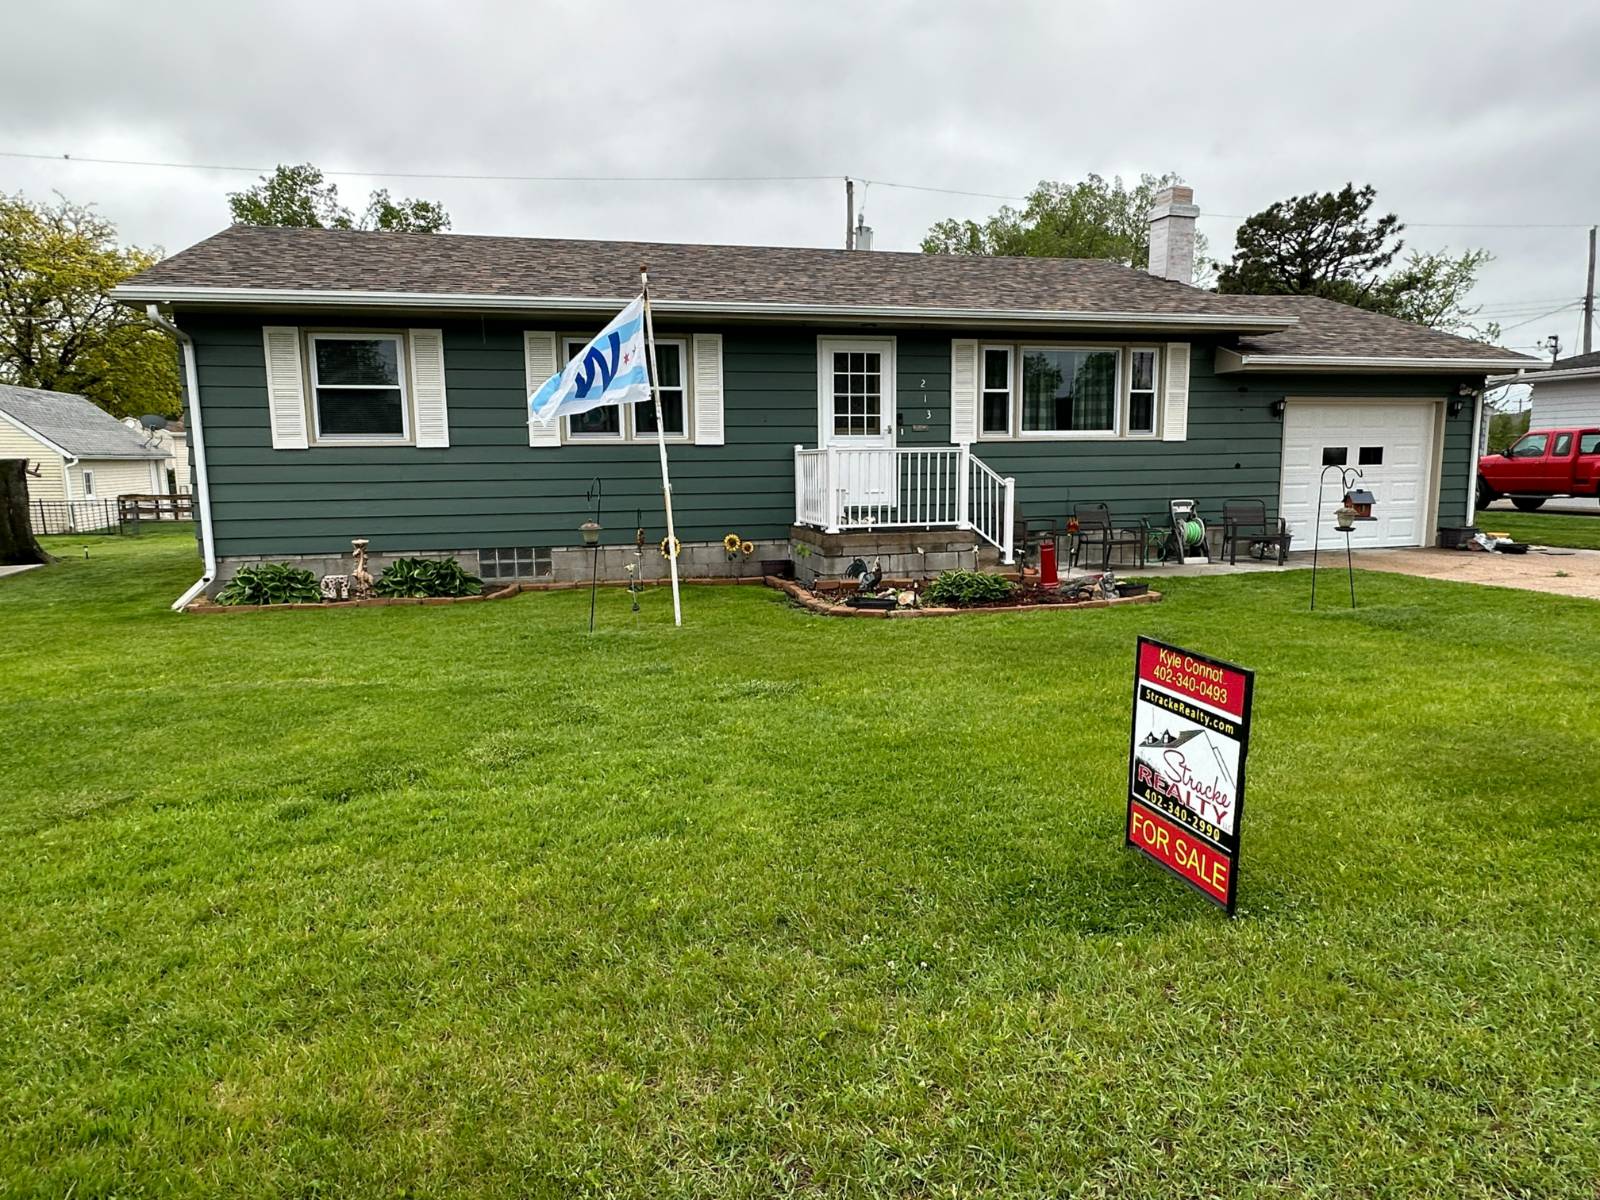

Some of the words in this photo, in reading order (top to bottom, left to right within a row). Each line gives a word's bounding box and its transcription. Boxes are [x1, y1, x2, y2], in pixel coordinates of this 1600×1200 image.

[1153, 665, 1228, 704] 402-340-0493
[1159, 648, 1181, 669] Kyle
[1184, 656, 1223, 684] Connot
[1145, 689, 1235, 735] StrackeRealty.com
[1137, 763, 1228, 825] REALTY
[1163, 749, 1231, 808] Stracke
[1144, 788, 1220, 841] 402-340-2990
[1132, 811, 1170, 856] FOR
[1174, 839, 1227, 893] SALE
